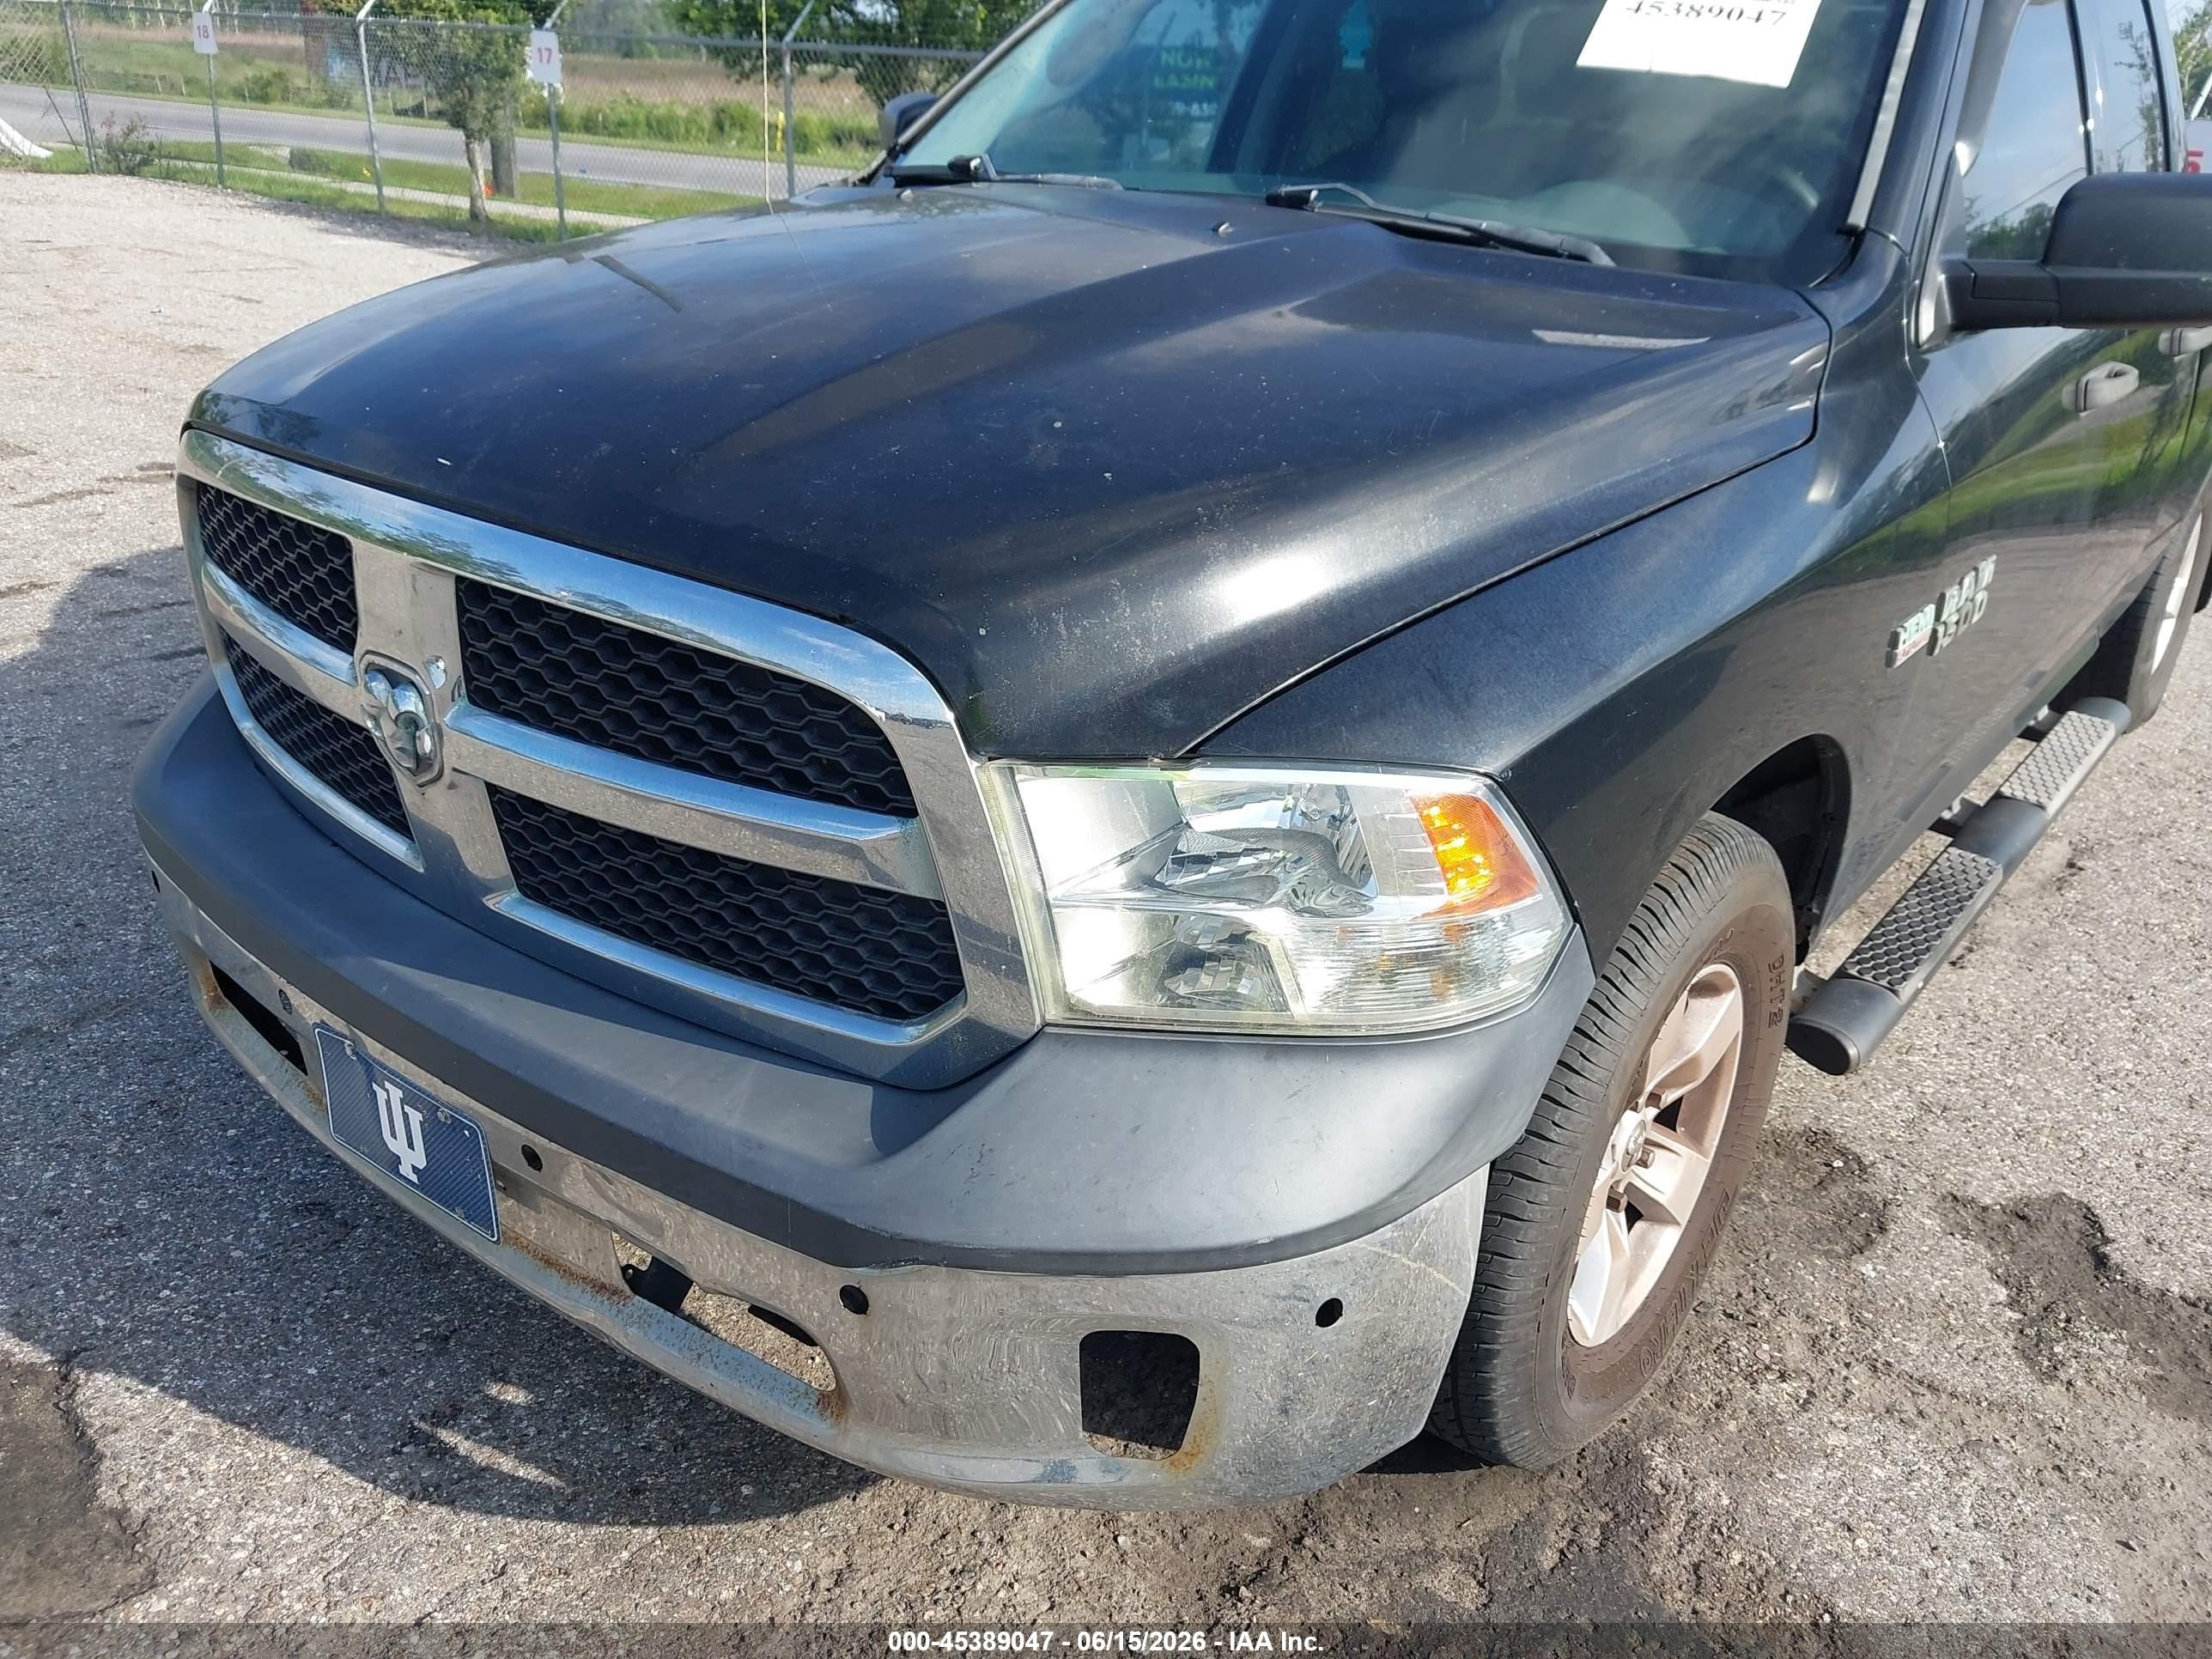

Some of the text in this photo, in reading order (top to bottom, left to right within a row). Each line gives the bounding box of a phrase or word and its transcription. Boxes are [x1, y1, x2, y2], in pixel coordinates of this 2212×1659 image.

[1625, 1, 1787, 26] 45389047
[197, 24, 210, 40] 18
[538, 46, 553, 65] 17
